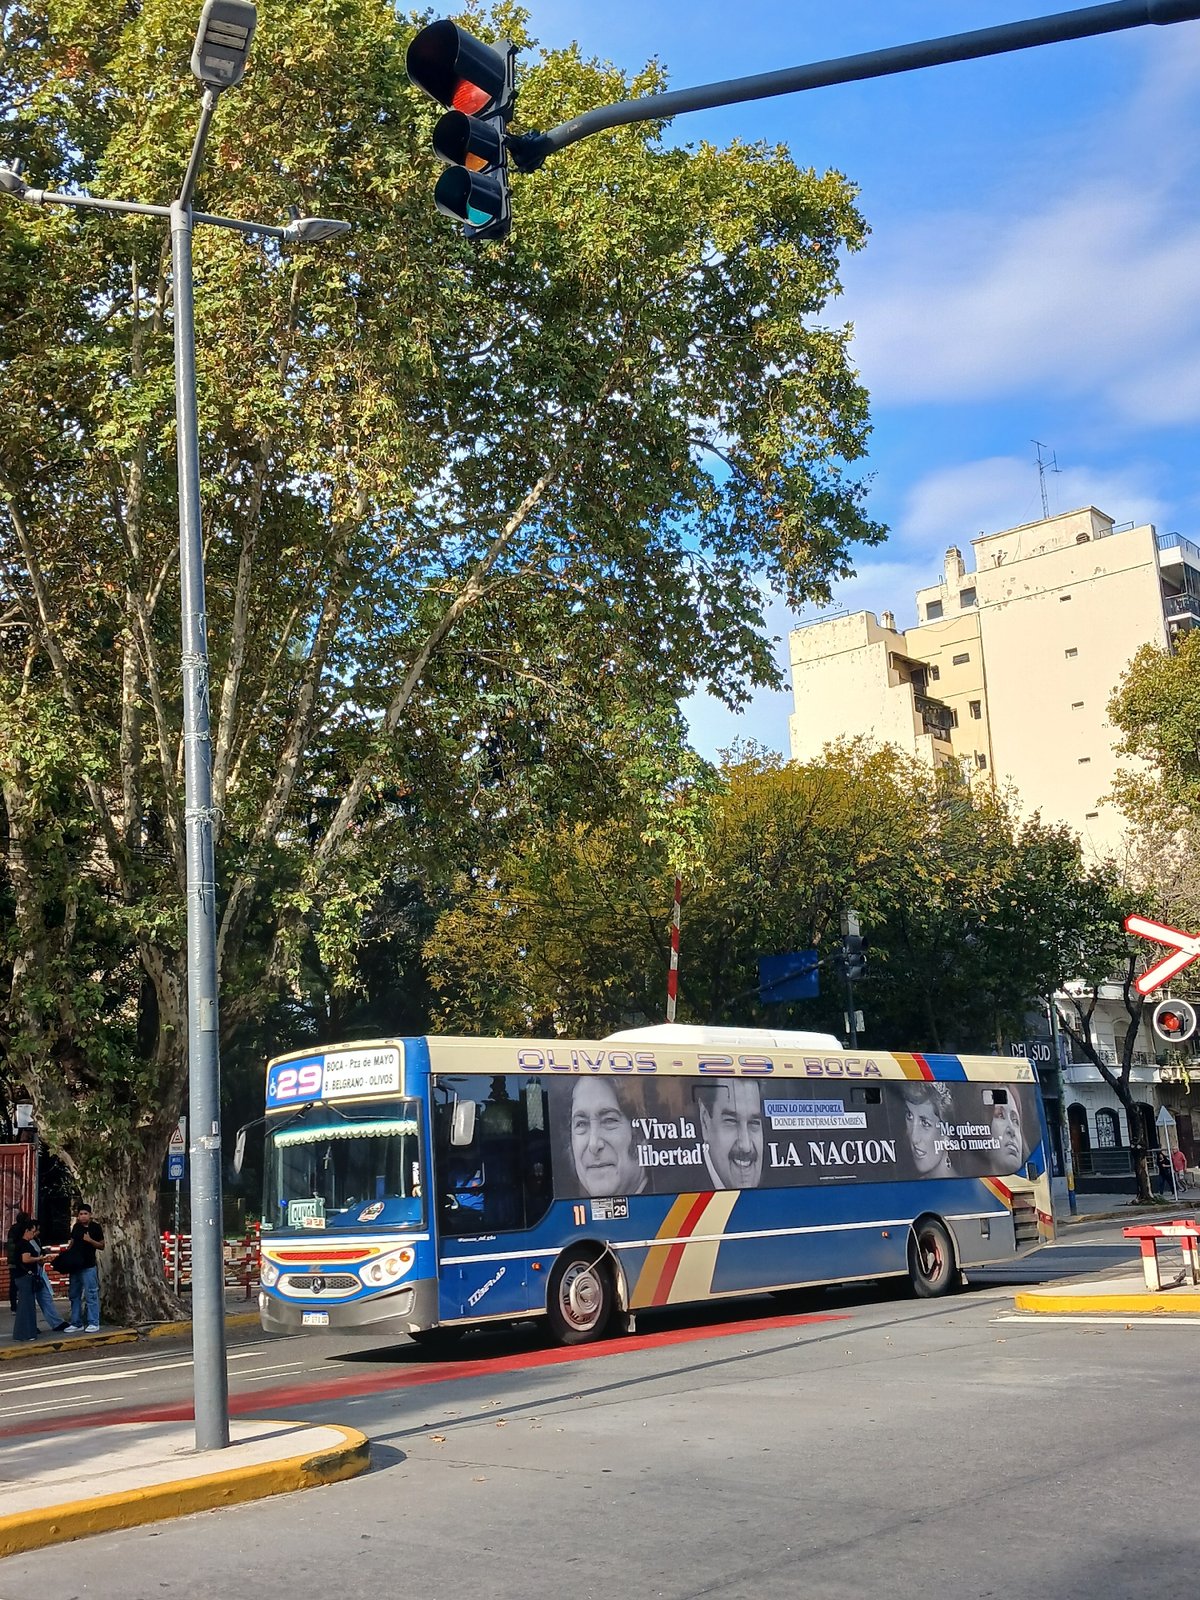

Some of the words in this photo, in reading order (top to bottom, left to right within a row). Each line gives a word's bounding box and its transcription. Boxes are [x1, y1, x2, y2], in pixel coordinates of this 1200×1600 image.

[1032, 1044, 1051, 1061] SUD
[326, 1060, 344, 1072] BOCA
[363, 1057, 372, 1067] de
[374, 1054, 394, 1066] MAYO
[517, 1049, 657, 1073] OLIVOS
[697, 1053, 774, 1075] 29
[803, 1057, 883, 1078] BOCA
[276, 1064, 323, 1099] 29
[332, 1077, 364, 1091] BELGRANO
[369, 1073, 393, 1086] OLIVOS
[789, 1104, 798, 1113] LO
[799, 1104, 814, 1113] DICE
[680, 1117, 696, 1139] la
[797, 1117, 806, 1126] TE
[956, 1121, 991, 1139] quieren
[636, 1143, 710, 1167] libertad”
[768, 1142, 803, 1167] LA
[808, 1140, 897, 1166] NACION
[934, 1140, 960, 1154] presa
[961, 1140, 967, 1150] o
[573, 1205, 586, 1226] 11
[613, 1205, 627, 1216] 29
